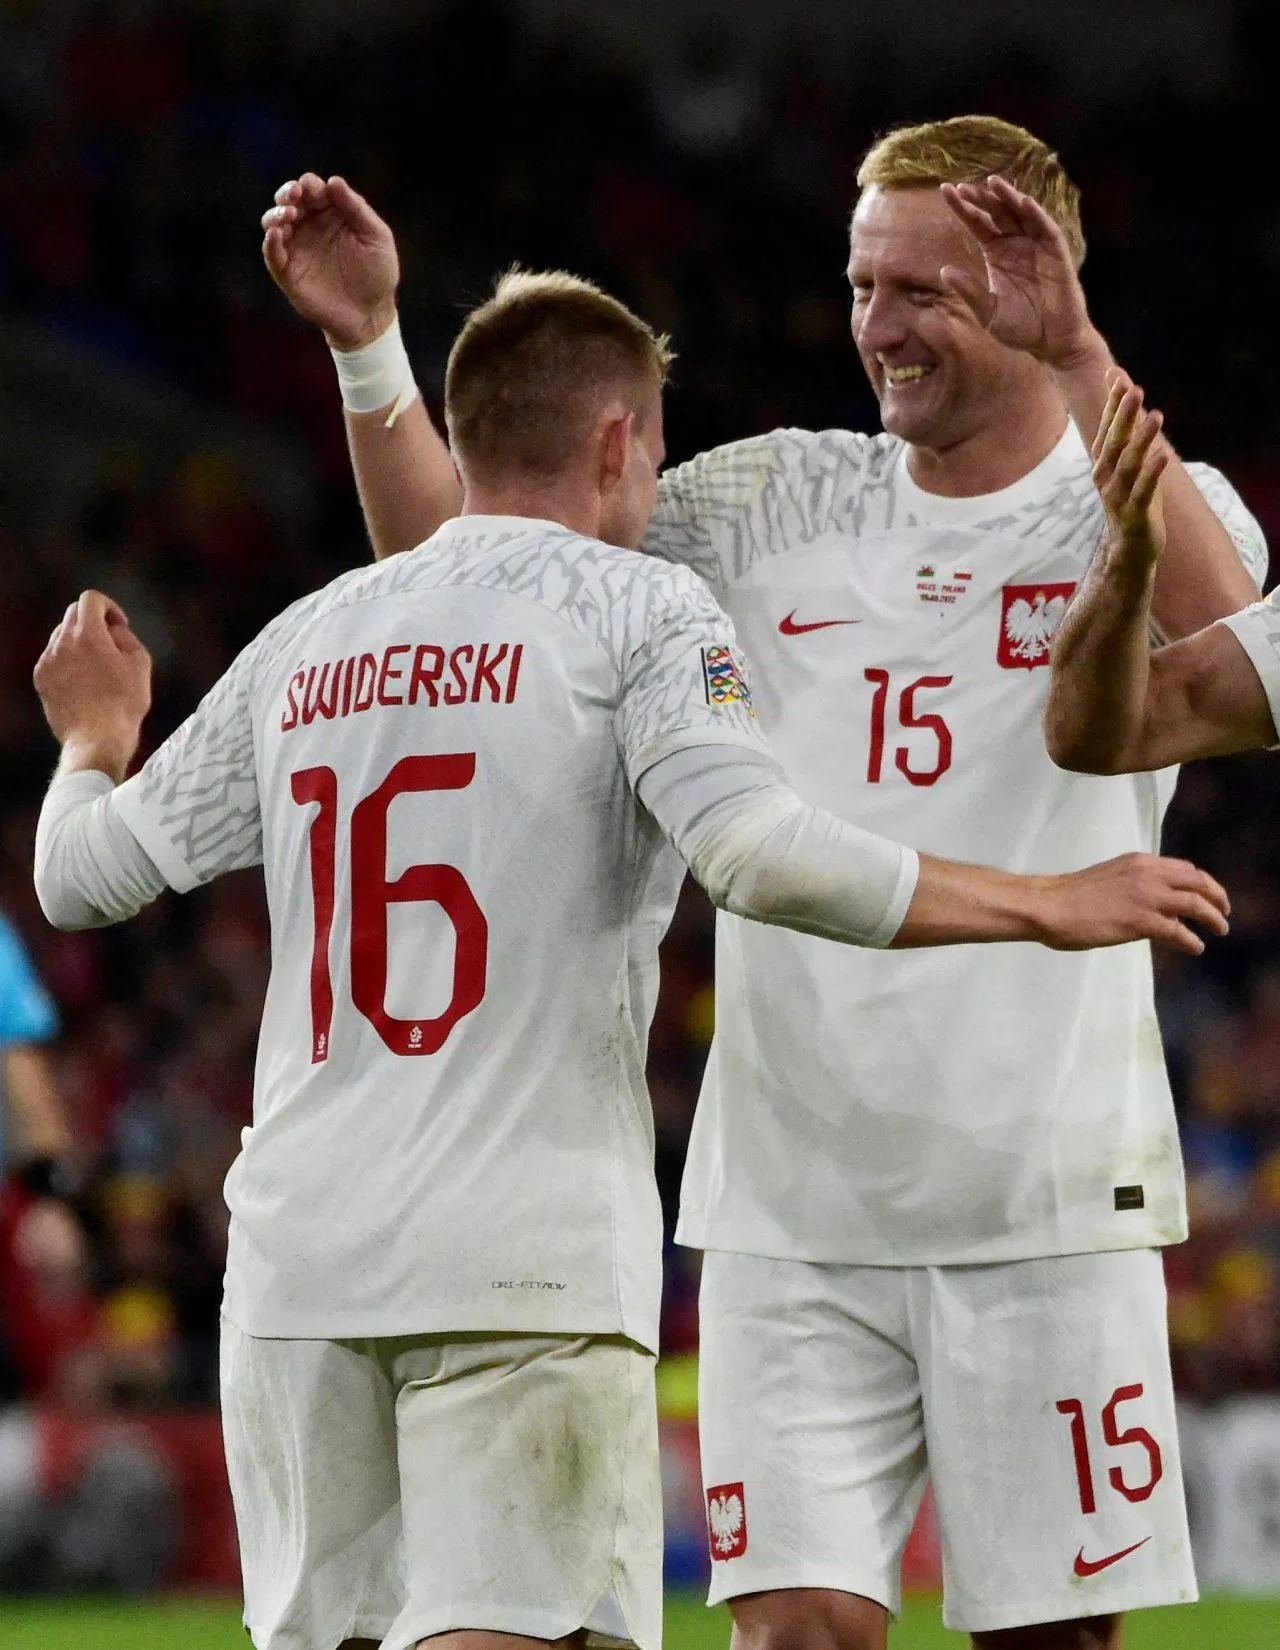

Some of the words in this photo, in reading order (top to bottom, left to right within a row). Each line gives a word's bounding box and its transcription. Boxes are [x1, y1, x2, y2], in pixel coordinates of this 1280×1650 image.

[281, 643, 524, 732] ŚWIDERSKI
[865, 668, 952, 786] 15
[291, 753, 488, 1063] 16
[1057, 1384, 1162, 1513] 15
